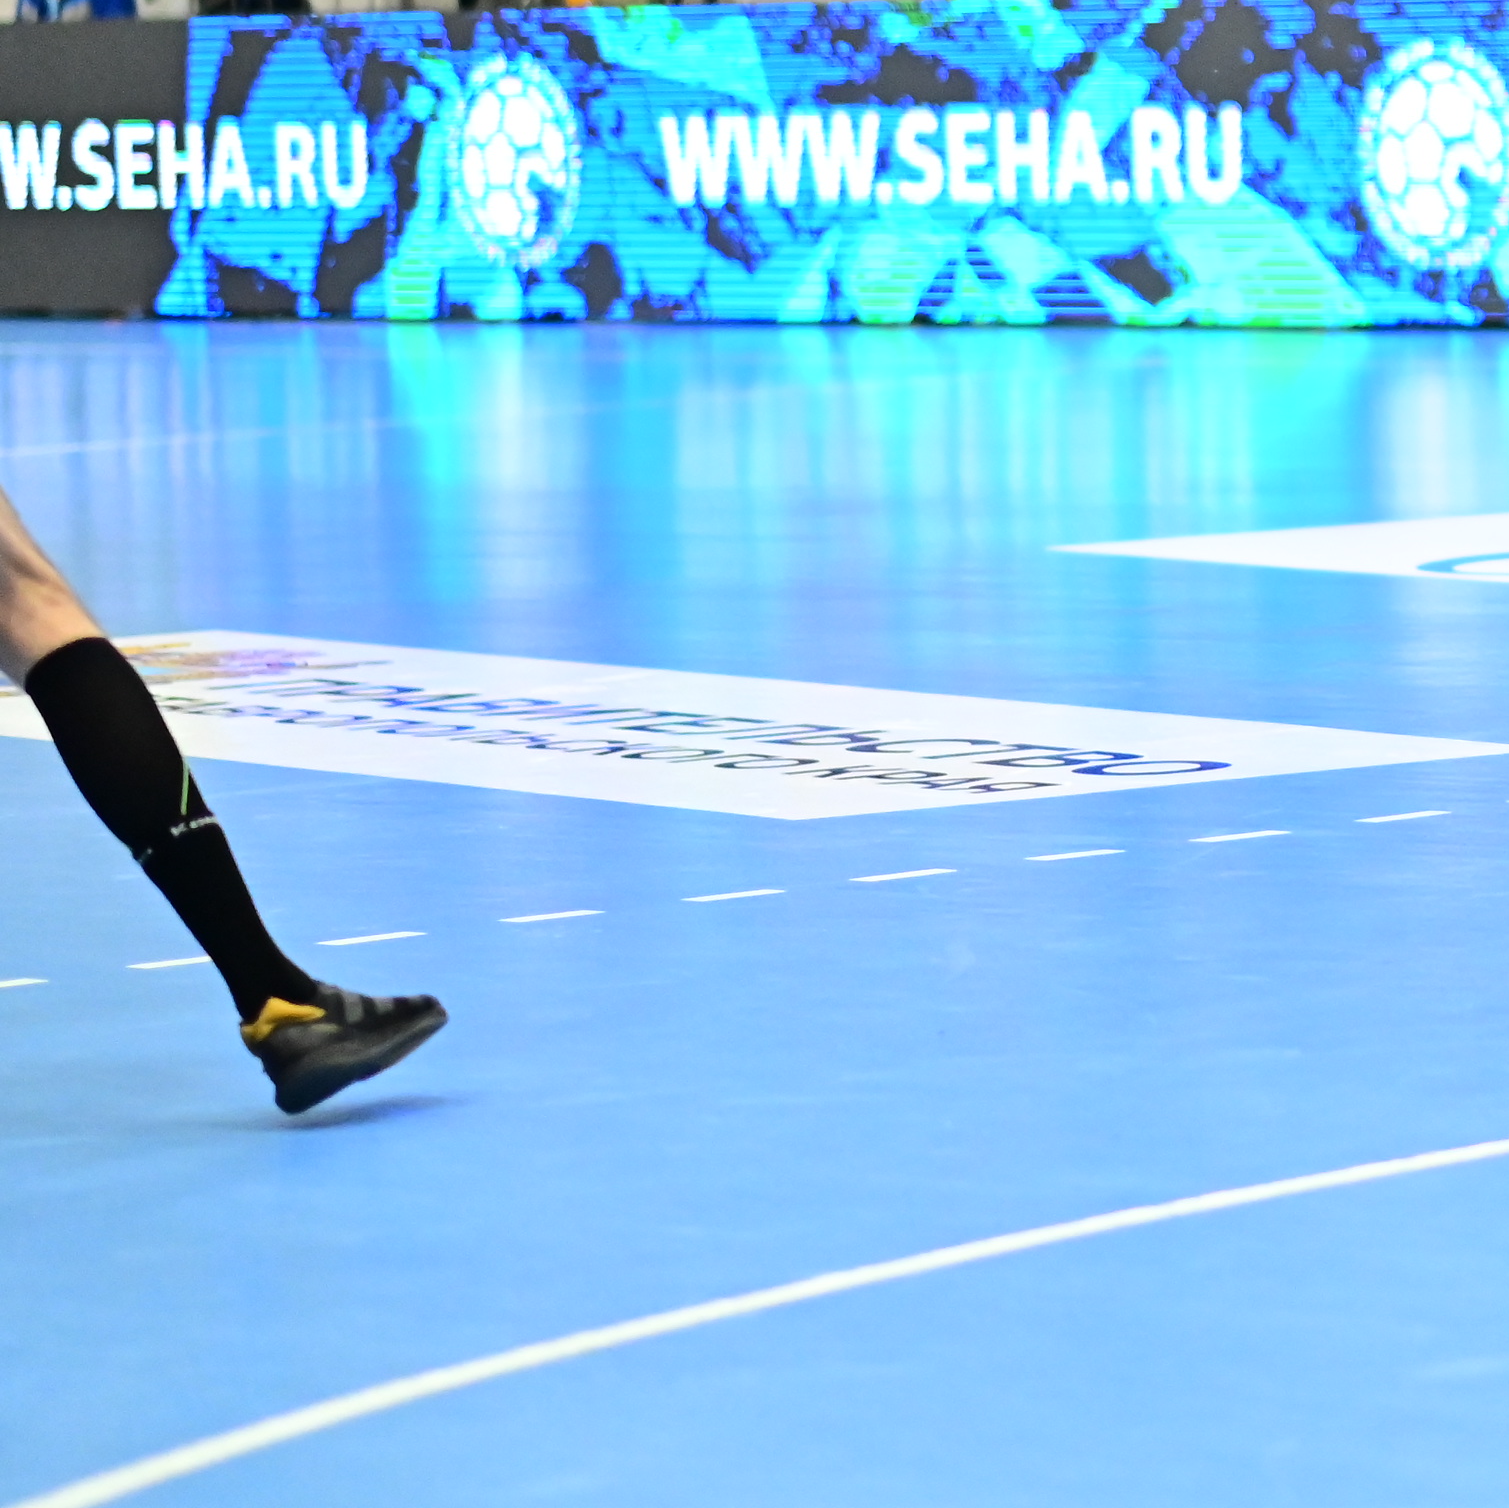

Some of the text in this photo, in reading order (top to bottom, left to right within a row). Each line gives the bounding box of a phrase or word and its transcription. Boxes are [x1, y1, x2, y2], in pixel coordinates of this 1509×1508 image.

[0, 117, 367, 211] W.SEHA.RU
[658, 105, 1243, 206] WWW.SEHA.RU
[150, 695, 1061, 794] ТАВРОПОЛЬСКОГО КРАЯ
